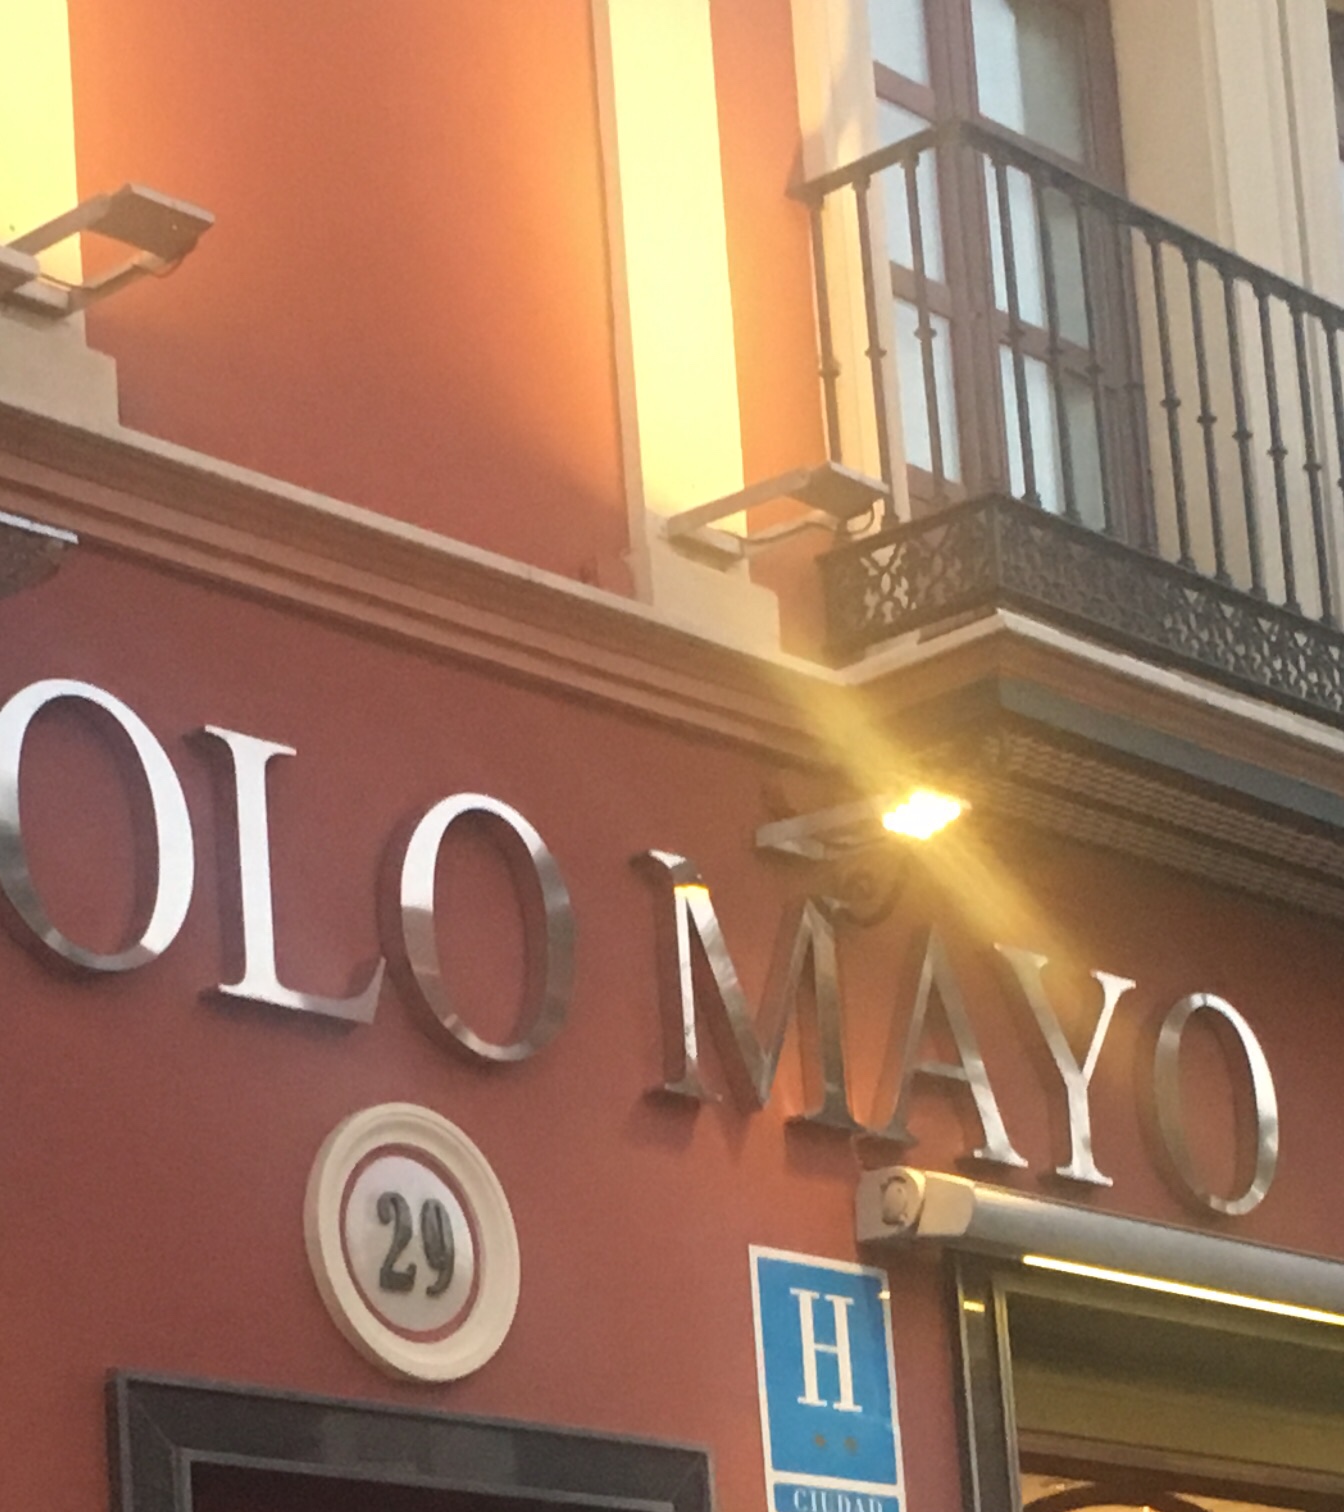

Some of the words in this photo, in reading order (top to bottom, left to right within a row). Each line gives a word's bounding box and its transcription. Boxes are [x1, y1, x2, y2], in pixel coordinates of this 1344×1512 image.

[644, 847, 1280, 1217] MAYO
[375, 1190, 455, 1297] 29
[789, 1287, 863, 1413] H
